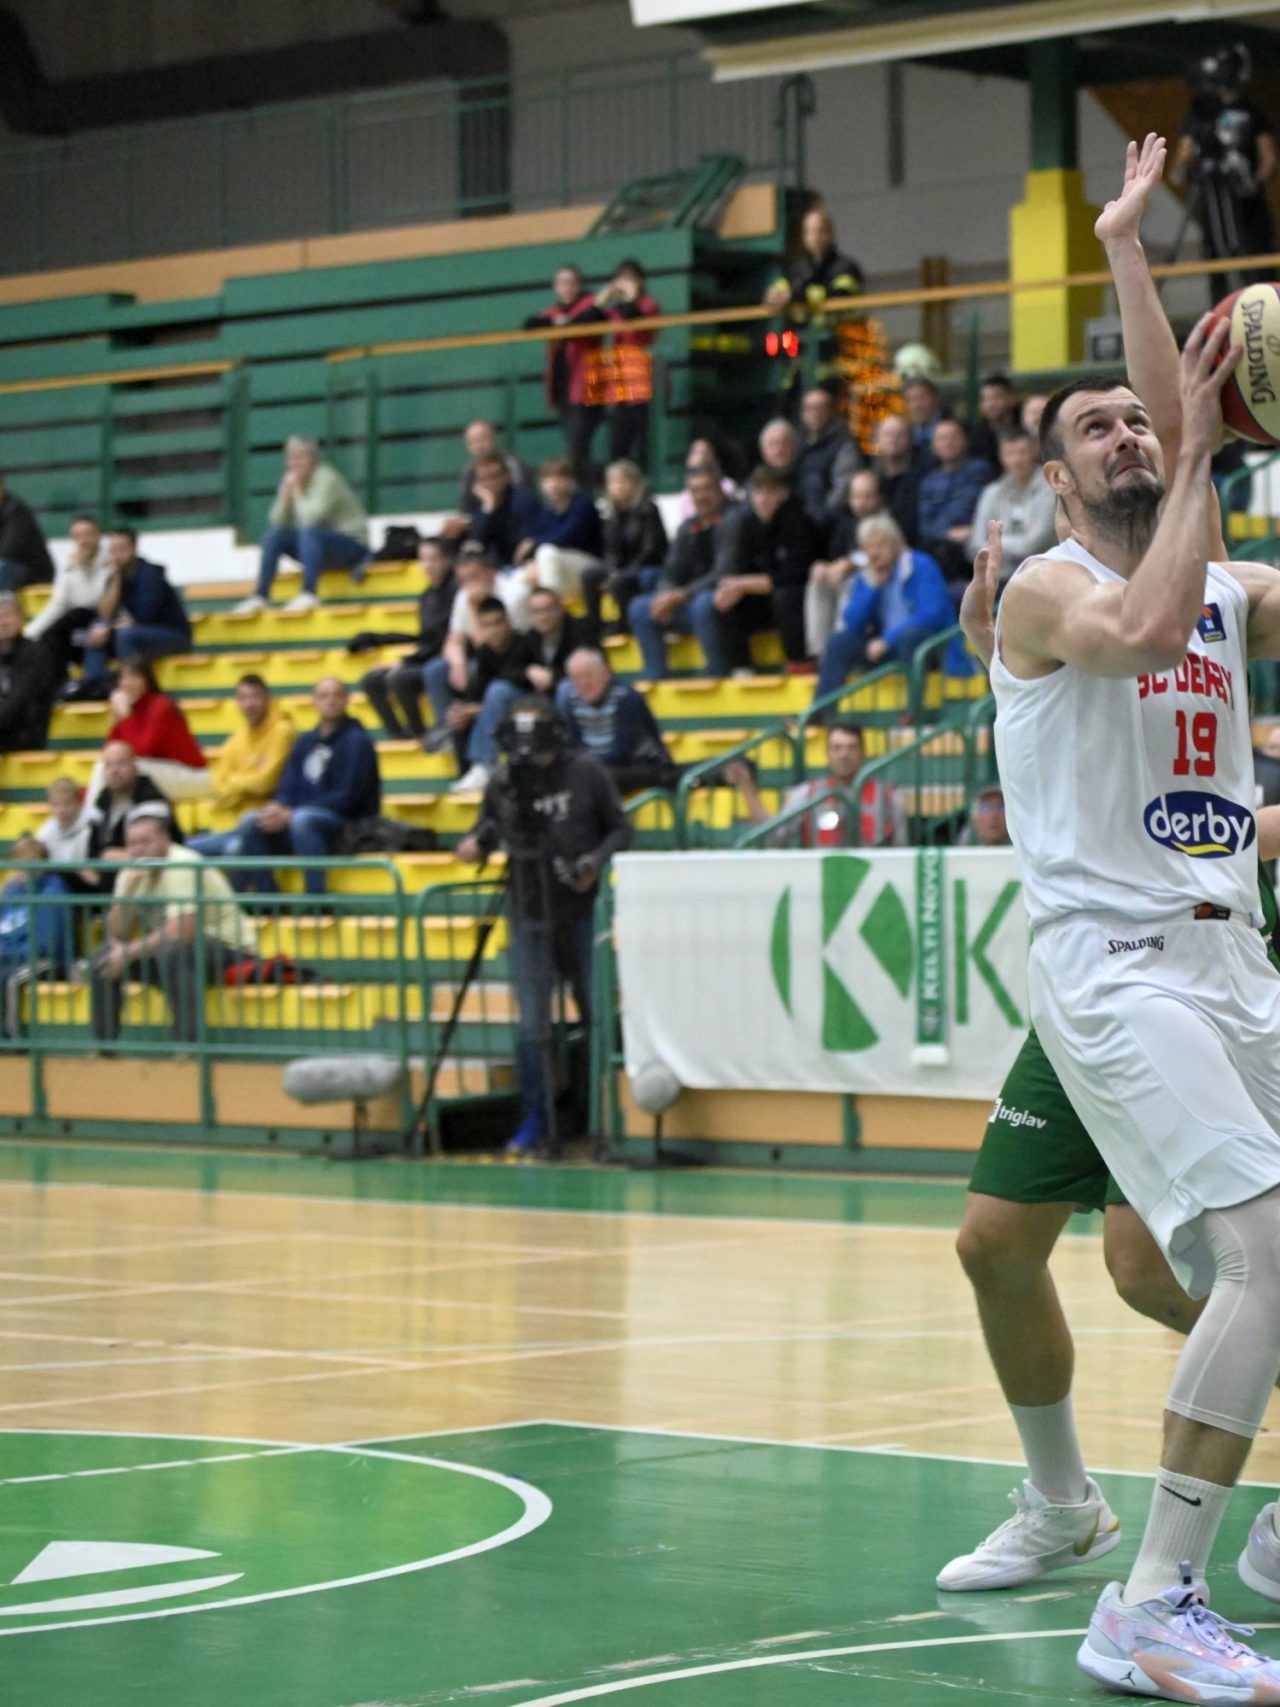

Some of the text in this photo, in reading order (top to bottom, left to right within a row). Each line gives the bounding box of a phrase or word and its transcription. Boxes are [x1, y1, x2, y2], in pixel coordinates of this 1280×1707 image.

[1241, 300, 1276, 404] SPALDING
[1173, 710, 1218, 777] 19
[1150, 795, 1251, 855] derby
[954, 879, 1024, 1027] K
[1108, 936, 1165, 955] SPALDING
[999, 1106, 1047, 1129] triglav
